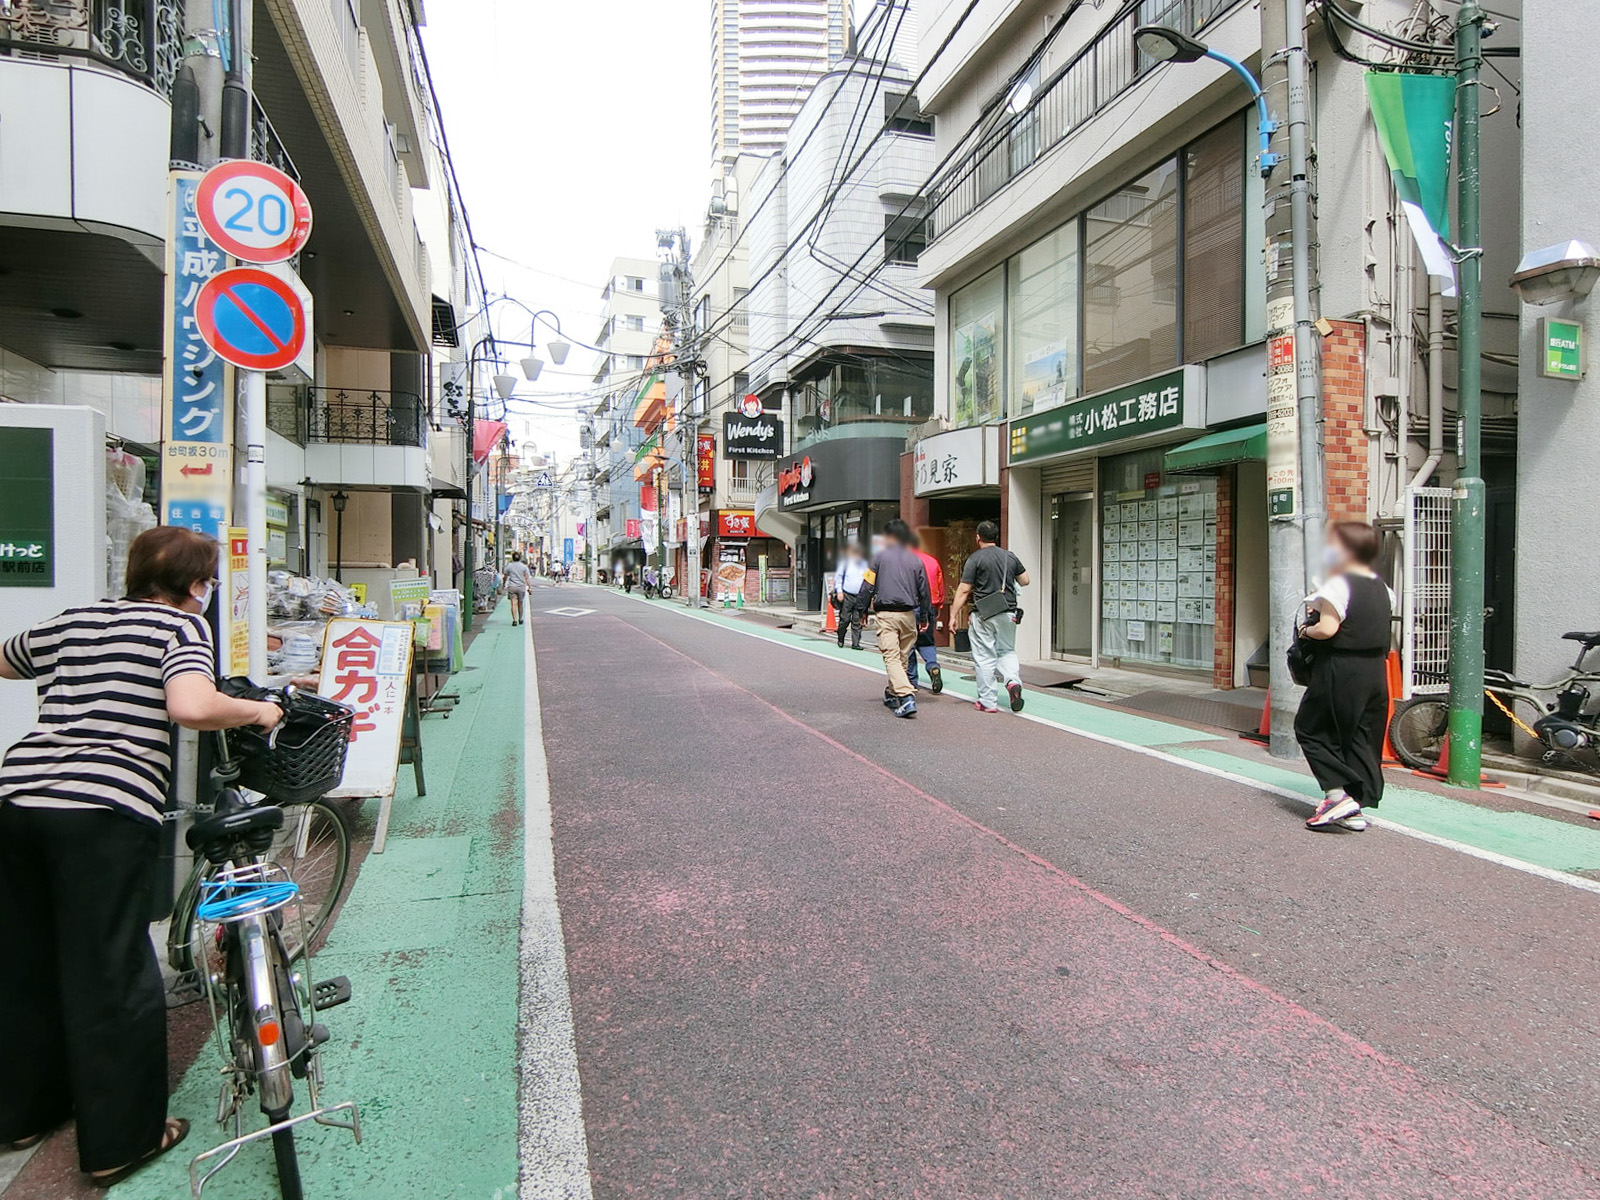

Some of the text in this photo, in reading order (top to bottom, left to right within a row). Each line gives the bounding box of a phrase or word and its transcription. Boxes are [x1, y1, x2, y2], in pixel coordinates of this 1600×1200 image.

[224, 188, 286, 236] 20
[727, 421, 774, 441] Wendy's
[1084, 386, 1179, 435] 小松工務店
